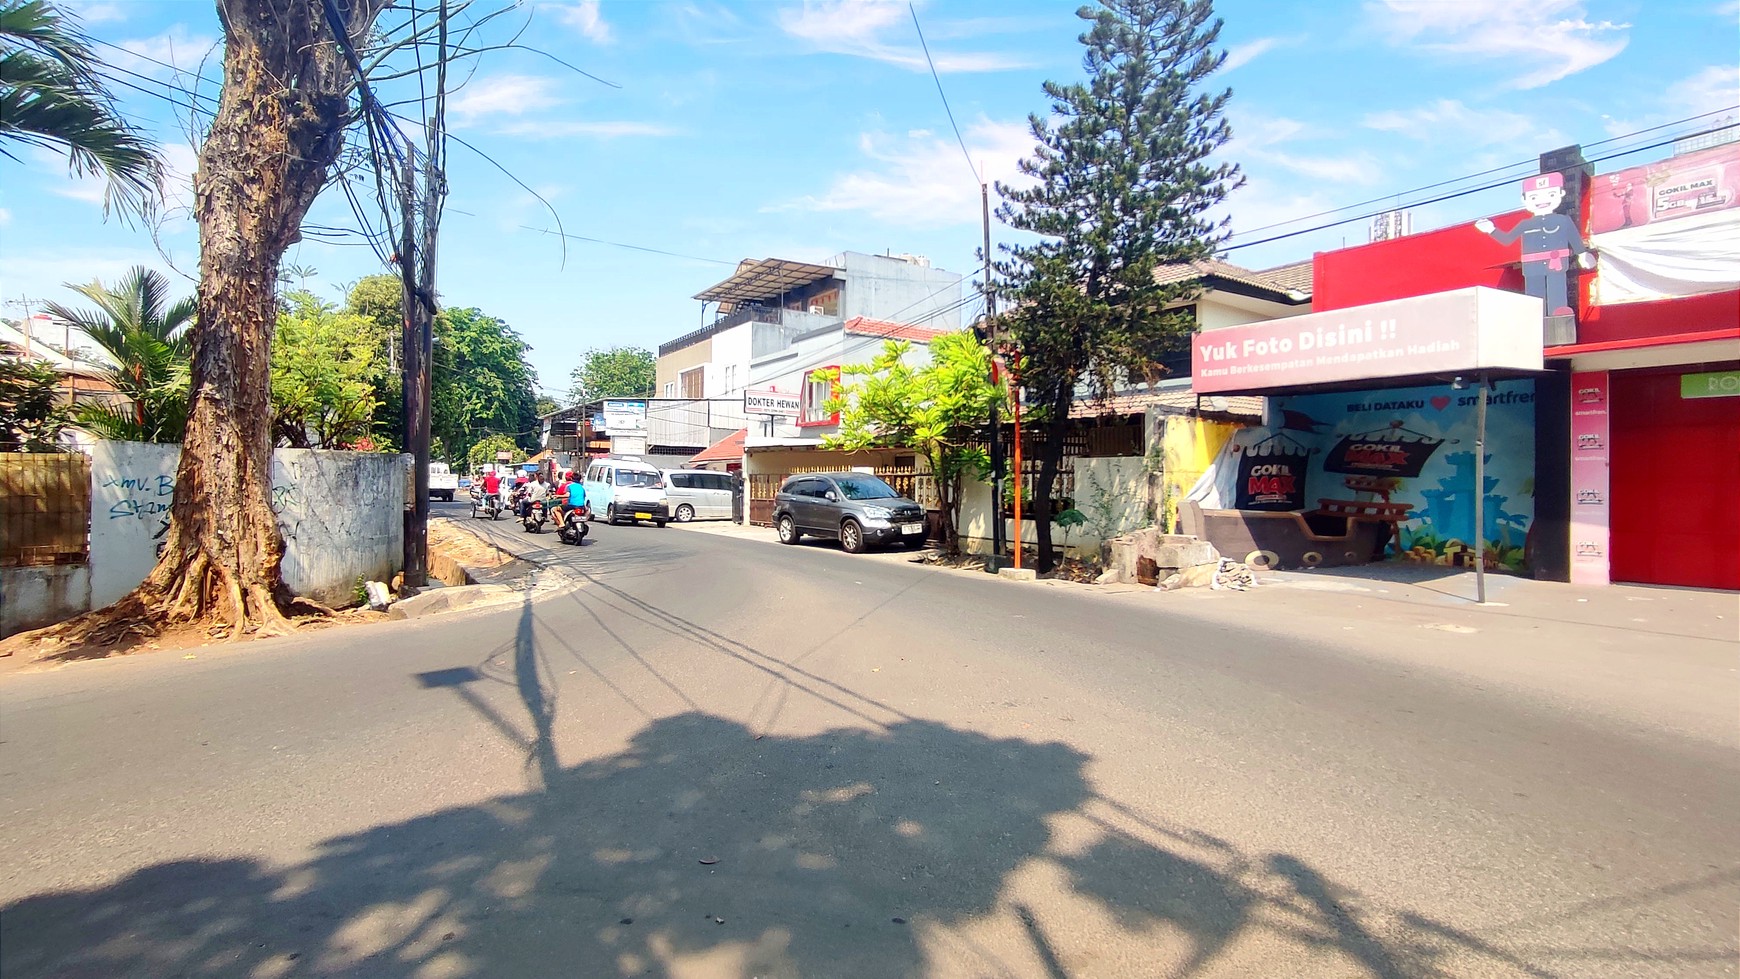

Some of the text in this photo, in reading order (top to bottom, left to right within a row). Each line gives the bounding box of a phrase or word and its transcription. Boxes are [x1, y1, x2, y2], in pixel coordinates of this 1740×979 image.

[1690, 179, 1713, 190] MAX
[1200, 319, 1396, 362] Yuk Foto Disini !!
[1201, 339, 1460, 377] Kamu Berkesempatan Mendapatkan Hadiah
[747, 396, 800, 409] DOKTER HEWAN
[1347, 402, 1373, 412] BELI
[1374, 400, 1425, 412] DATAKU
[1248, 476, 1296, 495] MAX
